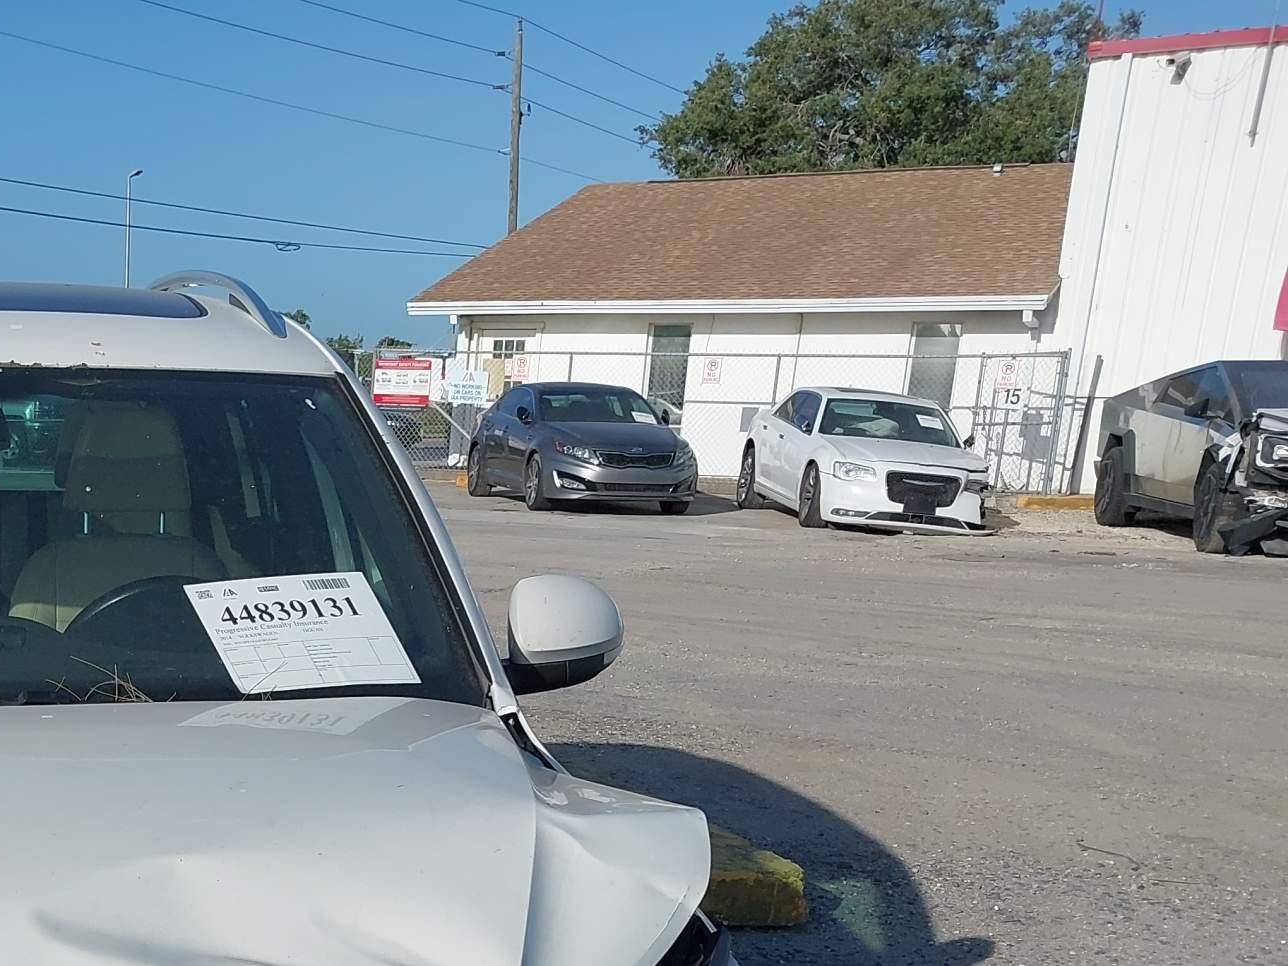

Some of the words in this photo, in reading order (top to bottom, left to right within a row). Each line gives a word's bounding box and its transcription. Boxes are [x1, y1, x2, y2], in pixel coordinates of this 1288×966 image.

[1004, 388, 1022, 405] 15
[220, 596, 362, 626] 44839131
[215, 625, 259, 636] Progressive
[260, 622, 293, 631] Casualty
[293, 619, 329, 627] Insurance
